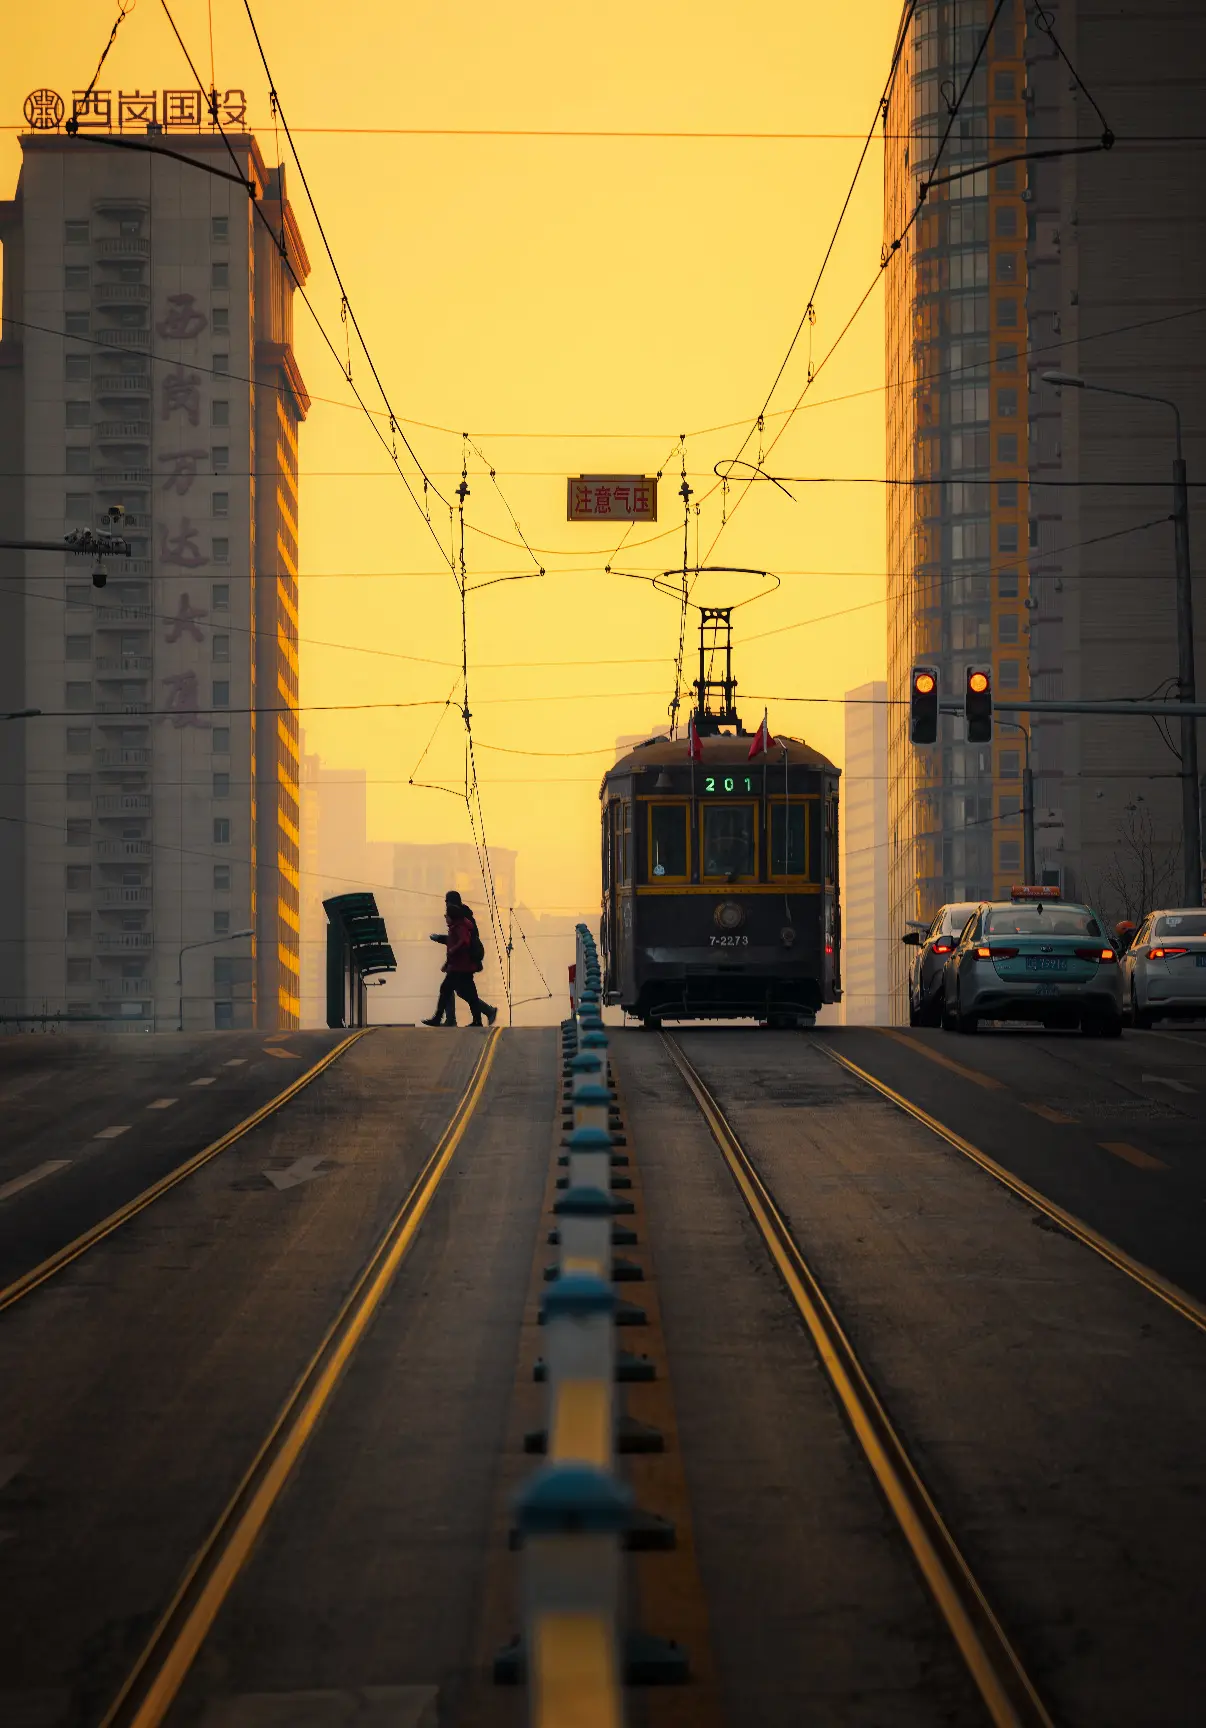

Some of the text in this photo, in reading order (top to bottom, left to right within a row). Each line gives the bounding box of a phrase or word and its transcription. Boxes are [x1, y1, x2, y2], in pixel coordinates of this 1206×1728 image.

[72, 89, 247, 125] 西岗国投
[575, 486, 650, 513] 注意气压
[705, 777, 750, 791] 201
[709, 935, 749, 946] 7-2273
